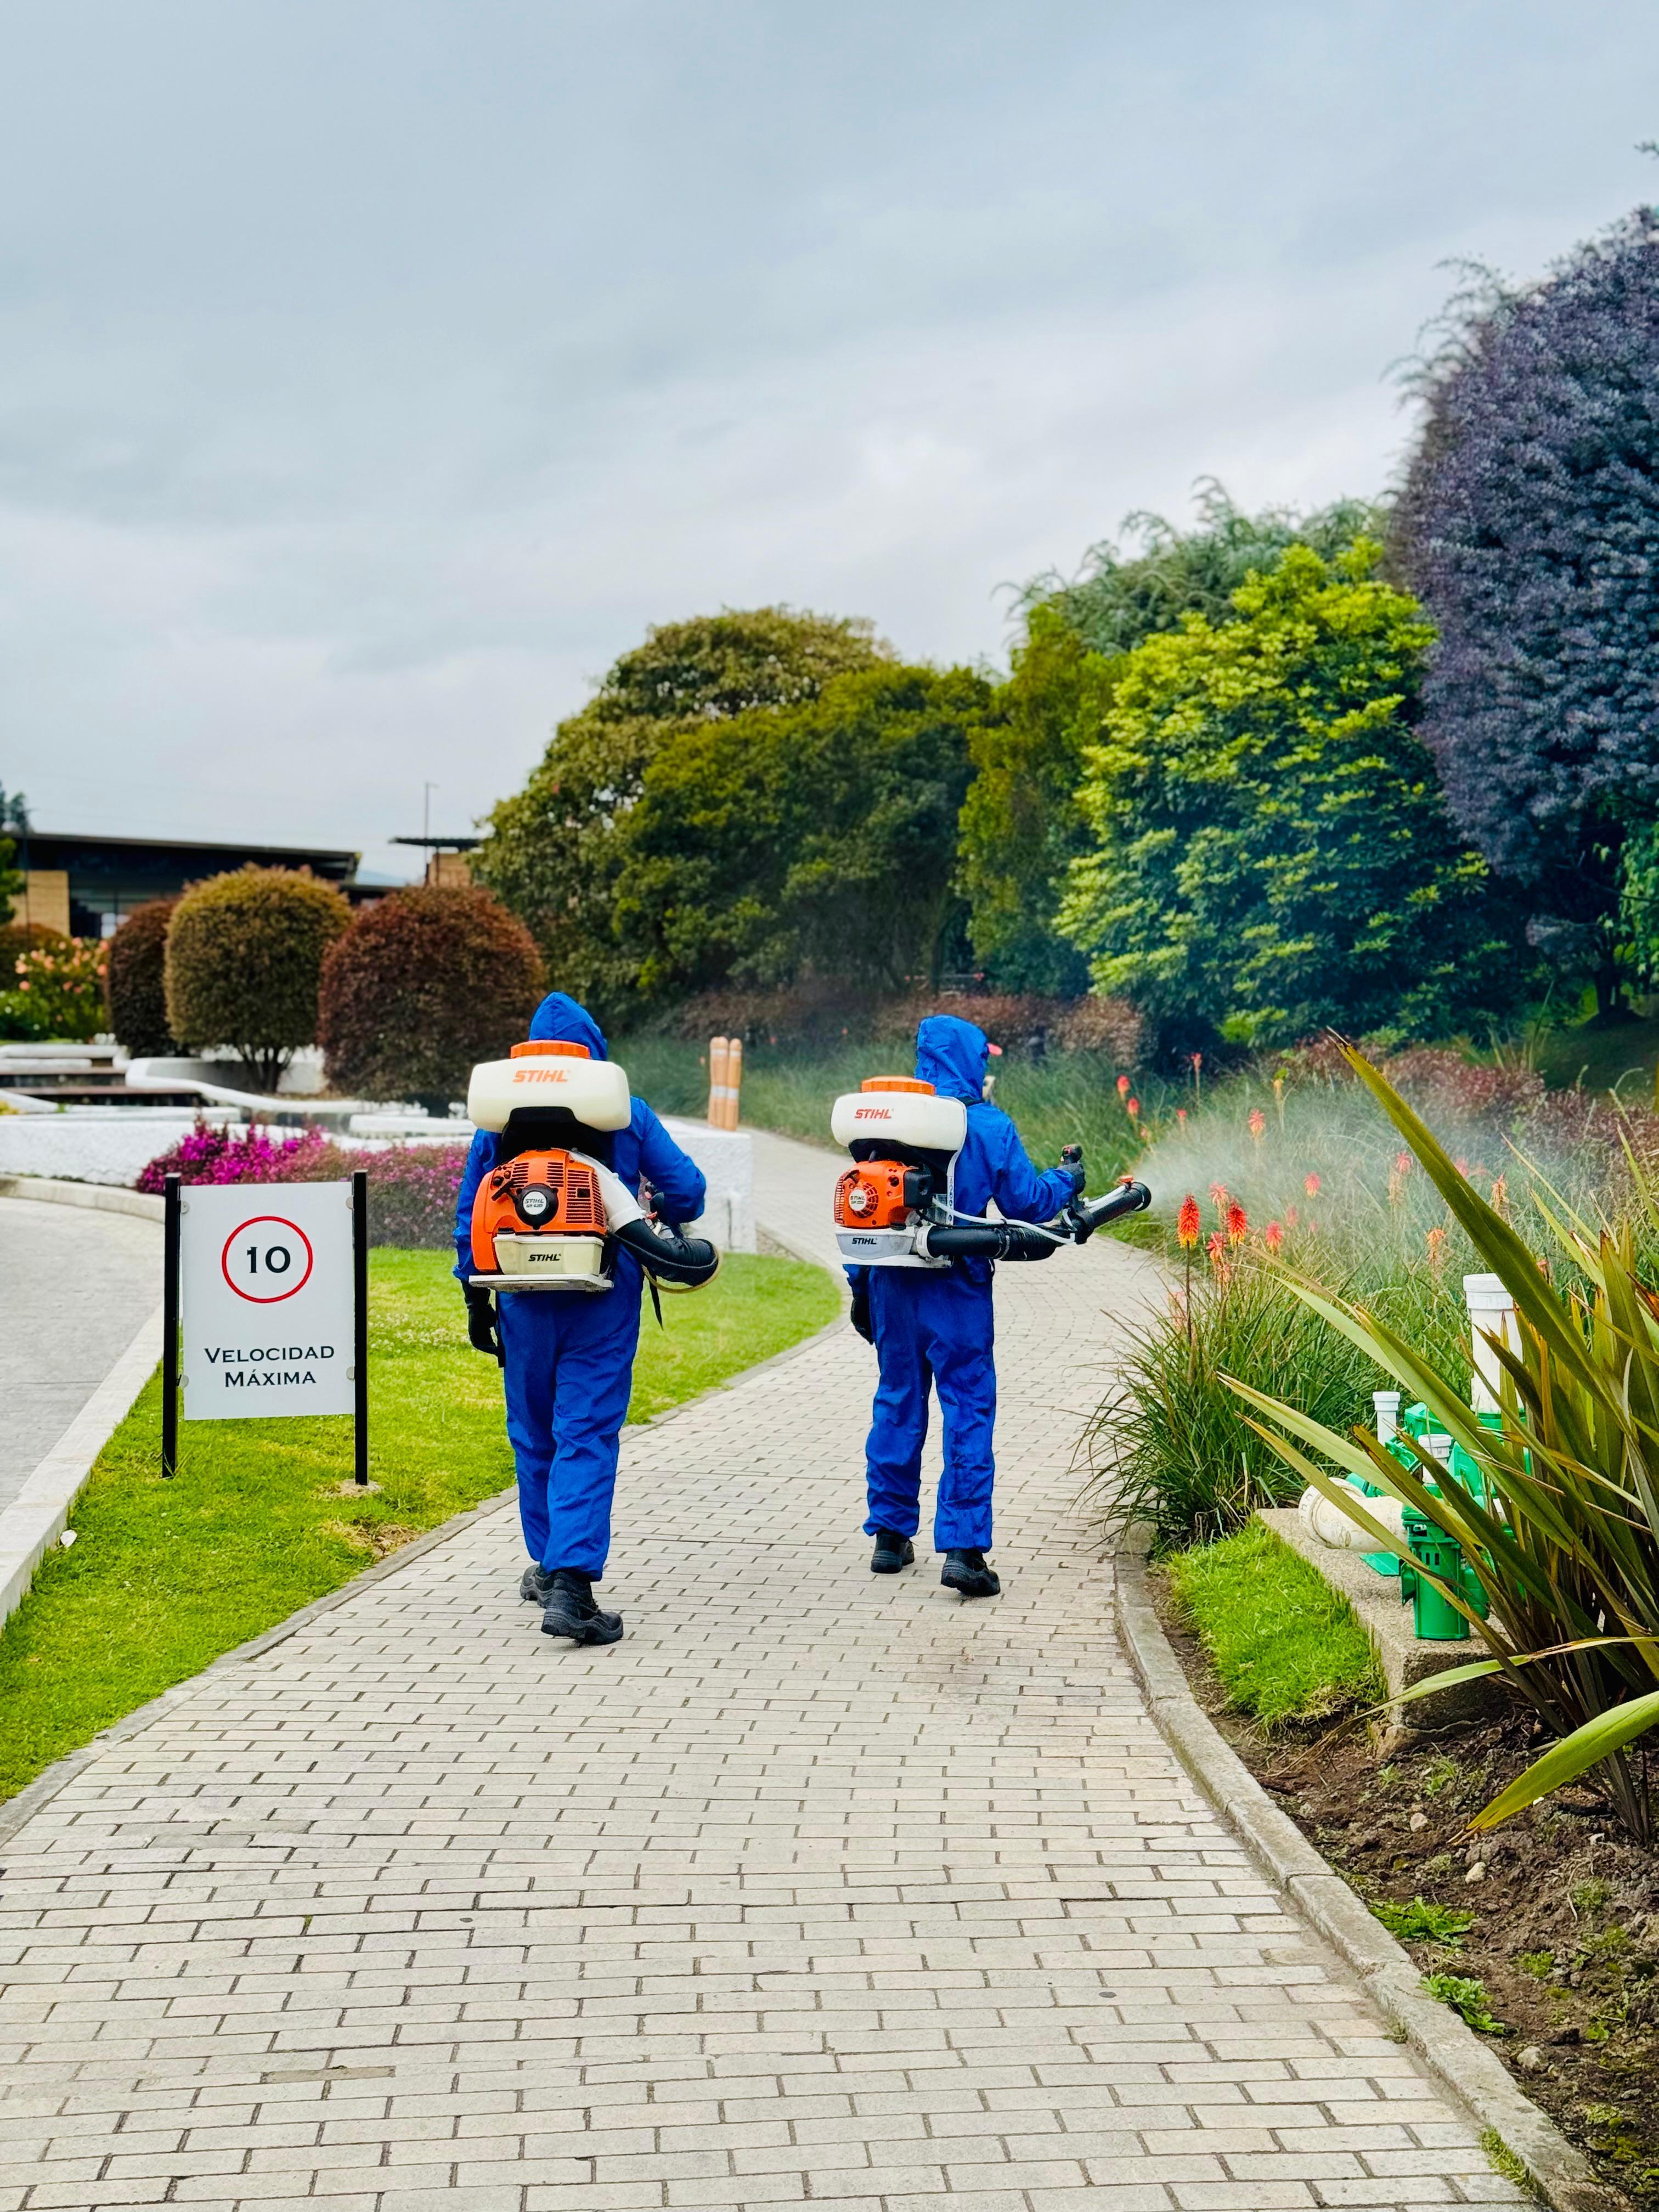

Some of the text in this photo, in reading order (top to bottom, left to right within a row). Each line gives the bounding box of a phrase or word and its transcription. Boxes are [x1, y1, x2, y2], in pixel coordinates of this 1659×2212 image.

[512, 1070, 568, 1082] STIHL
[854, 1109, 892, 1119] STIHL
[247, 1246, 291, 1273] 10
[204, 1346, 335, 1363] VELOCIDAD
